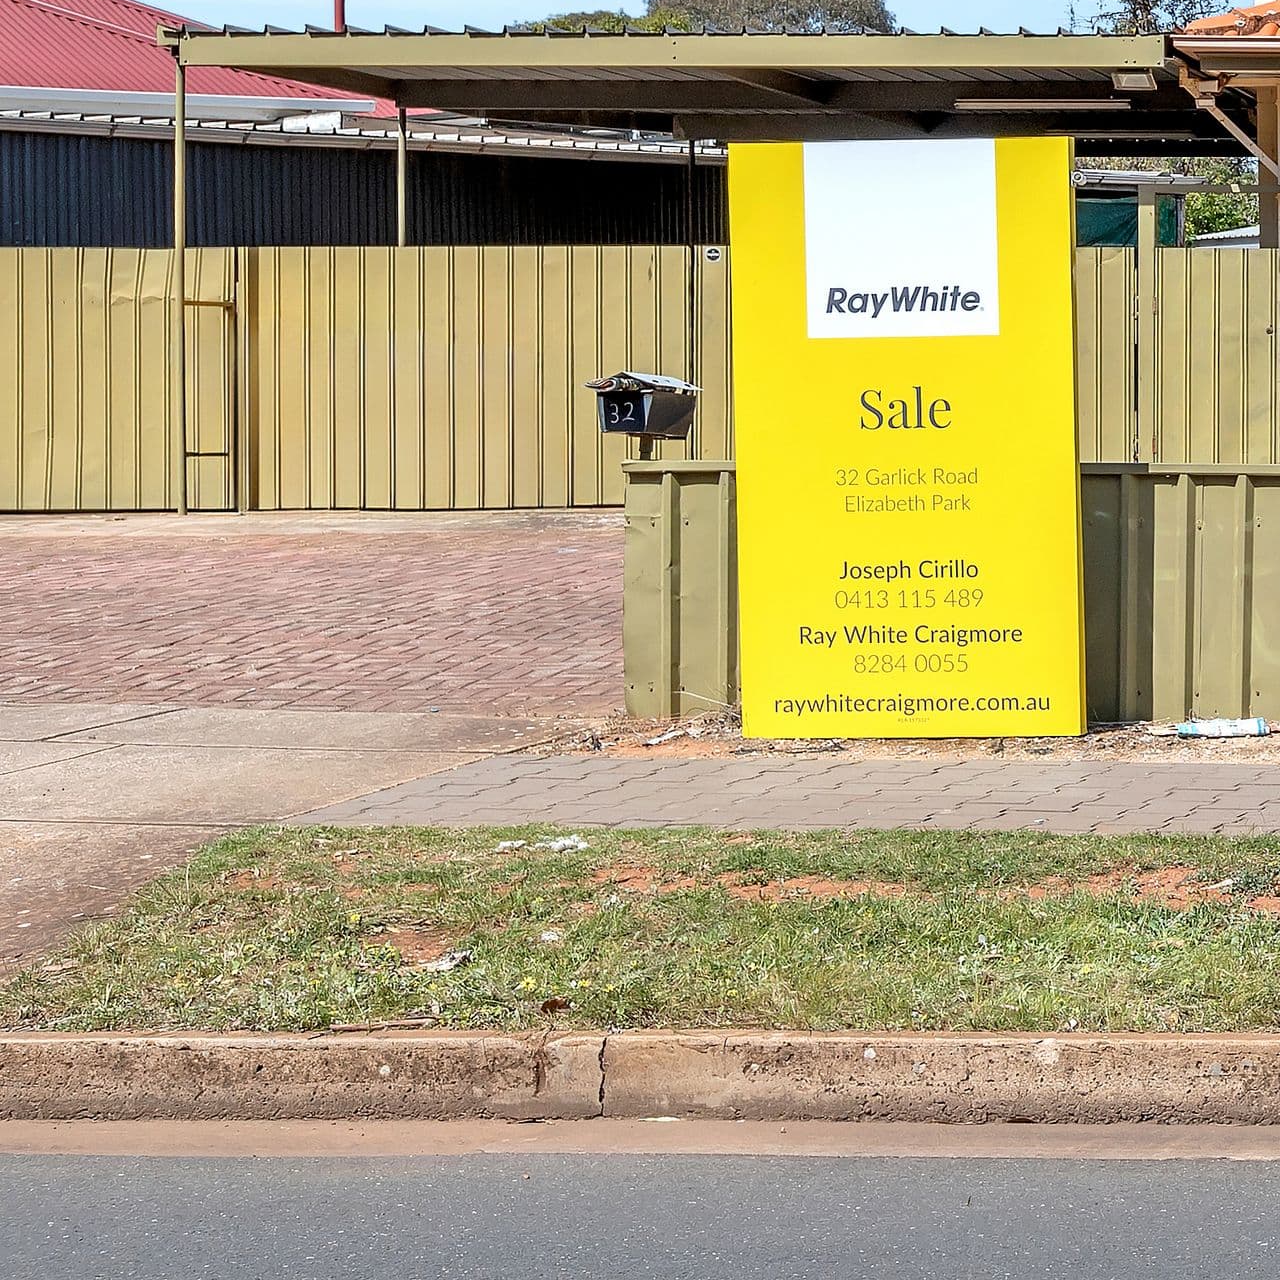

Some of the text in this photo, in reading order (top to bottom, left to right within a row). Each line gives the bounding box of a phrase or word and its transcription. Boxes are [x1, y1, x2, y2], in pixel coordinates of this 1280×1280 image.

[609, 402, 635, 424] 32
[861, 386, 951, 430] Sale
[836, 467, 978, 486] 32 Garlick Road
[845, 493, 971, 512] Elizabeth Park
[840, 559, 979, 582] Joseph Cirillo
[835, 588, 984, 609] 0413 115 489
[800, 625, 1022, 647] Ray White Craigmore
[854, 654, 968, 673] 8284 0055
[774, 694, 1050, 715] raywhitecraigmore.com.au
